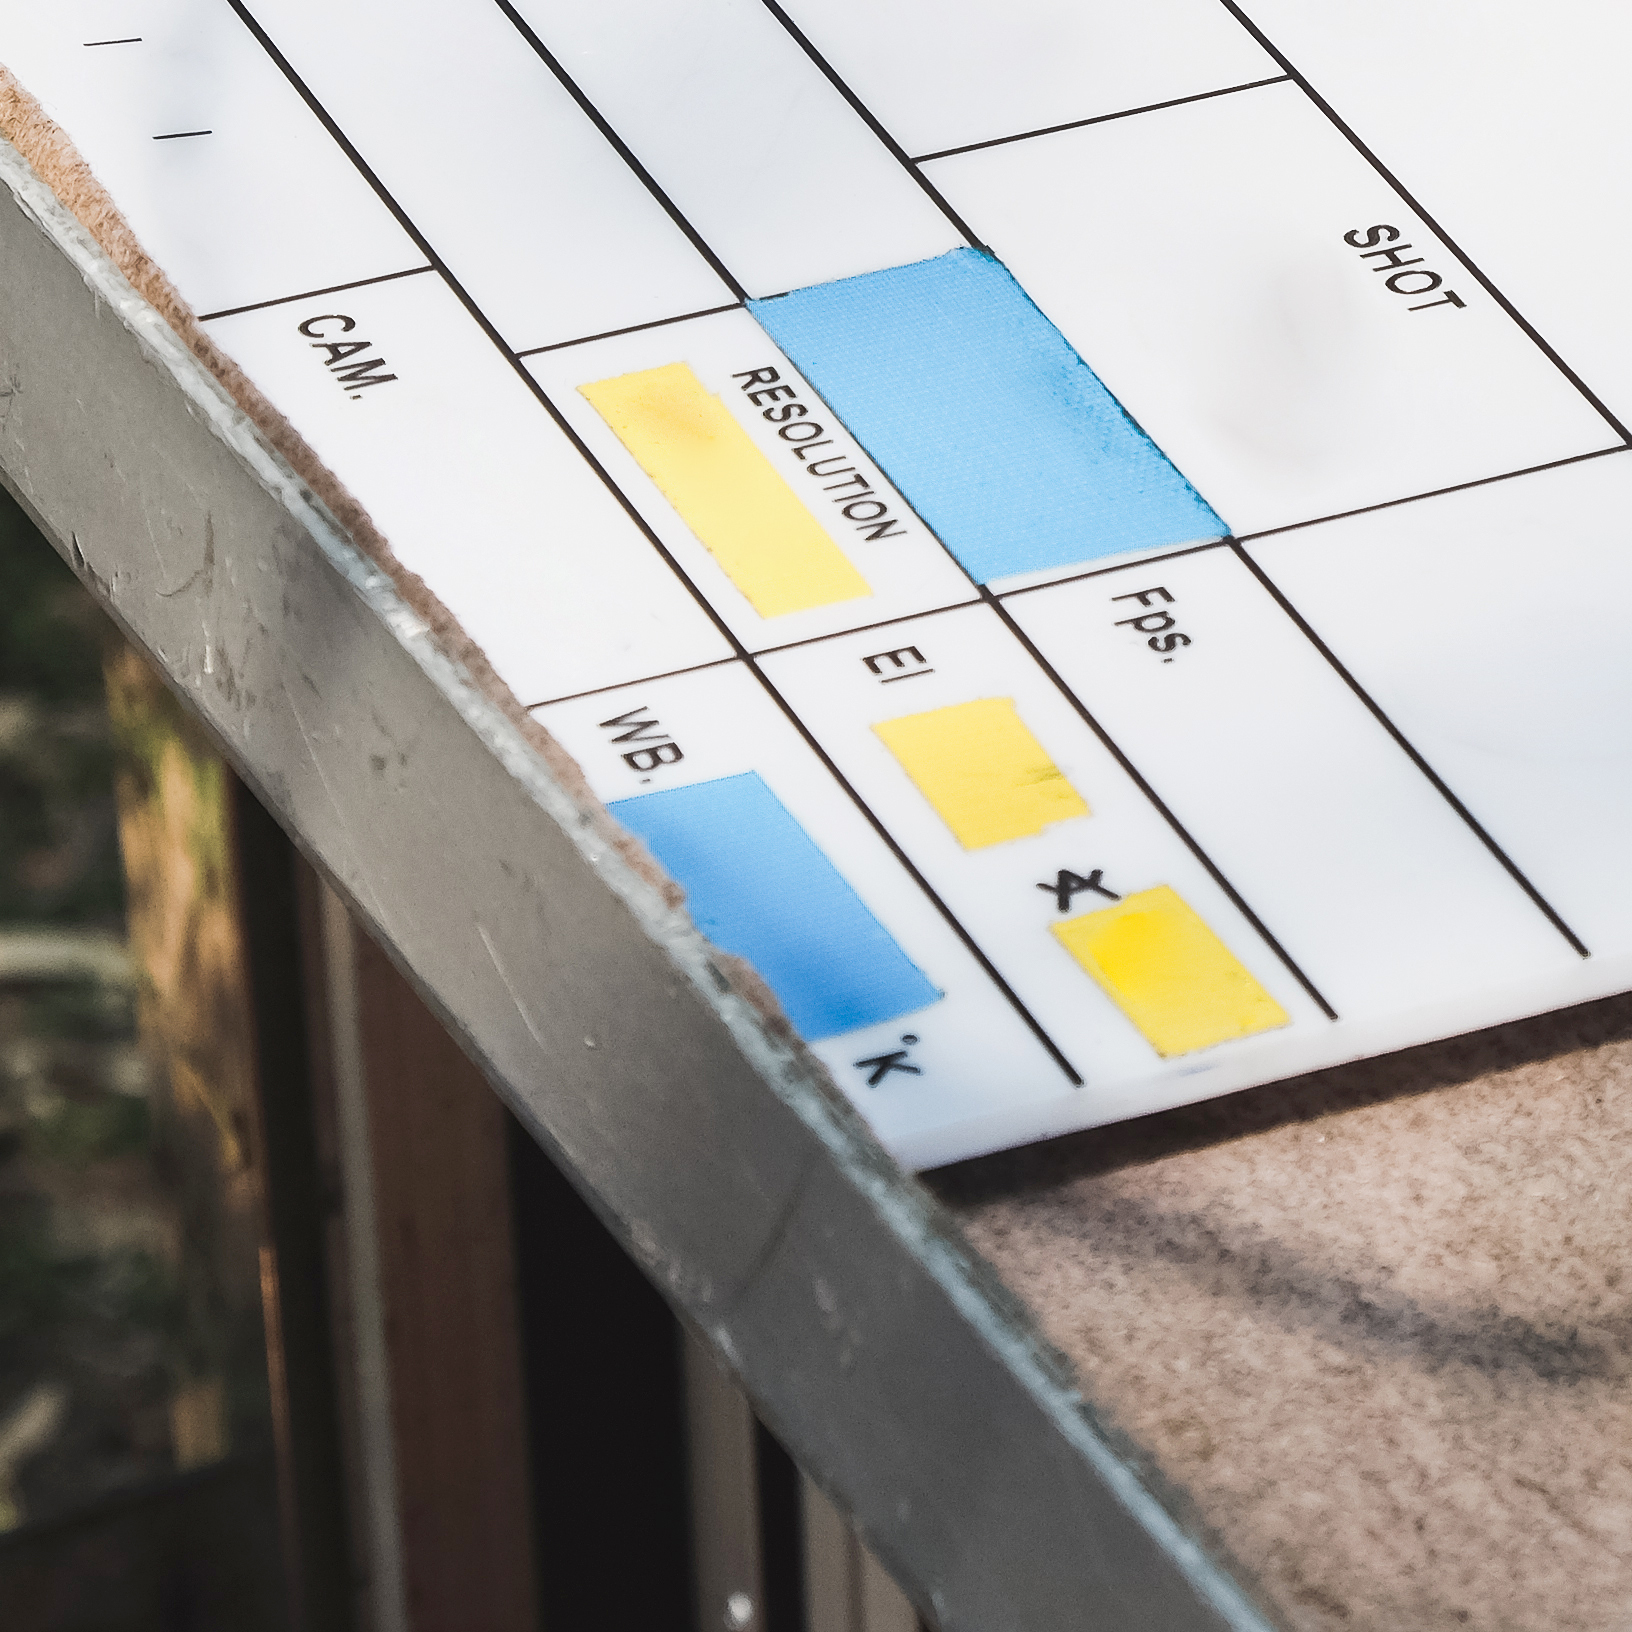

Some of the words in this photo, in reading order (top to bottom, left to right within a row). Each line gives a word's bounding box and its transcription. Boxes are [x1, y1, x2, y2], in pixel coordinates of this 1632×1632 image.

[1342, 223, 1469, 313] SHOT
[296, 313, 400, 401] CAM.
[731, 365, 908, 545] RESOLUTION
[1110, 585, 1193, 664] Fps.
[598, 705, 685, 785] WB.
